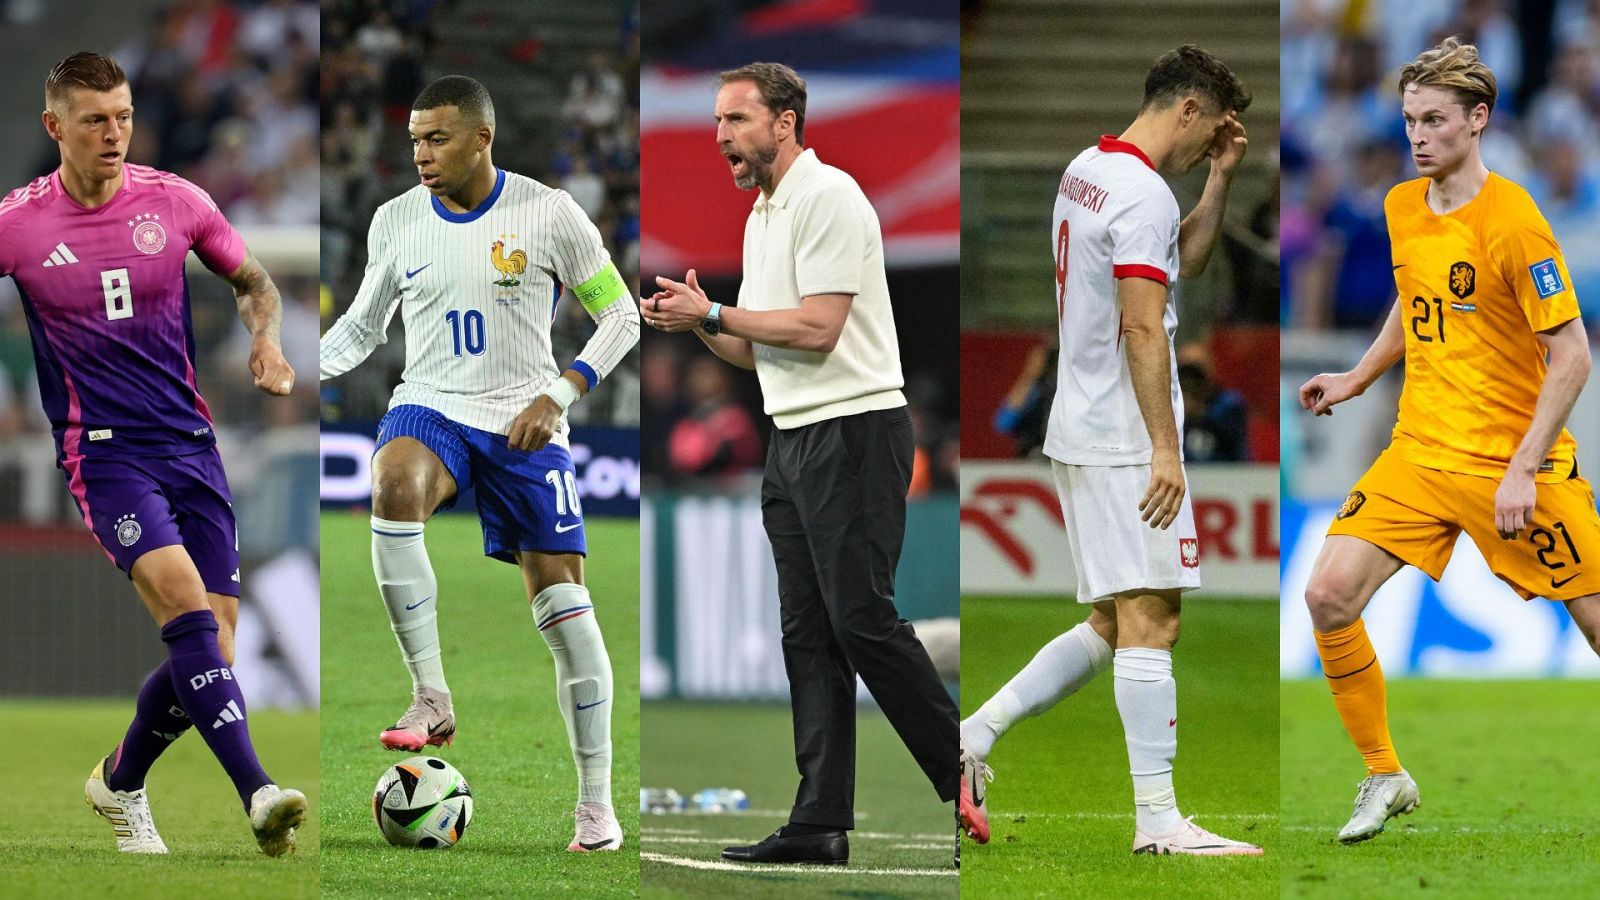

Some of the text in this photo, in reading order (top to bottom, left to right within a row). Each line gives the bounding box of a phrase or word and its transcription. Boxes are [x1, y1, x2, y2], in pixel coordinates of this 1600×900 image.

[101, 268, 134, 321] 8
[1056, 219, 1070, 325] 9
[445, 309, 487, 358] 10
[1412, 295, 1446, 343] 21
[545, 469, 581, 517] 10
[1529, 521, 1582, 570] 21
[189, 667, 233, 691] DFB
